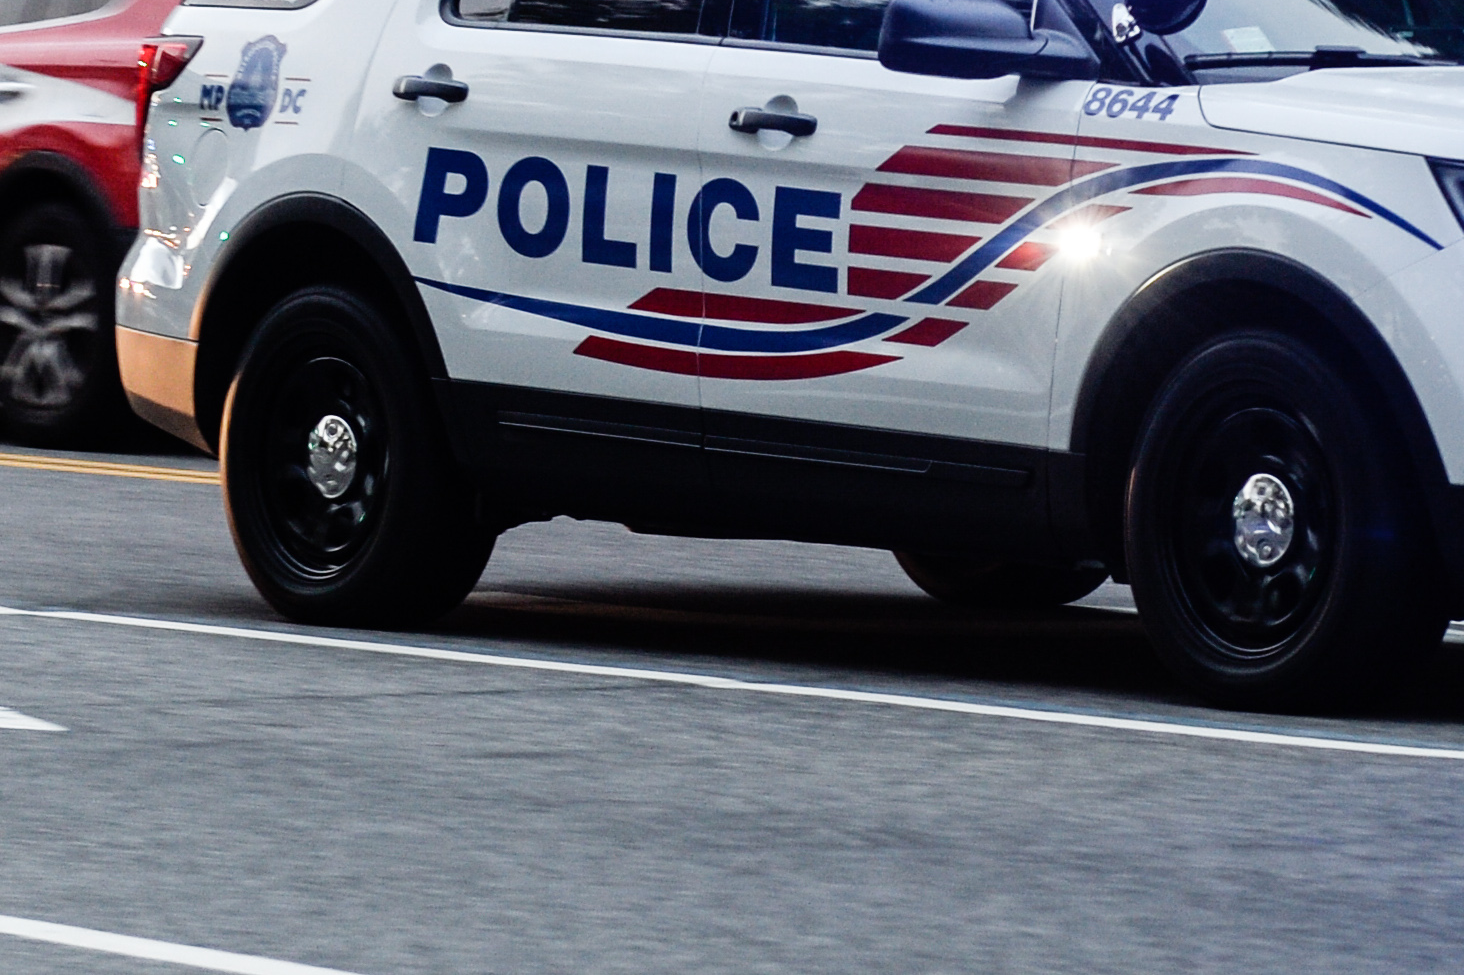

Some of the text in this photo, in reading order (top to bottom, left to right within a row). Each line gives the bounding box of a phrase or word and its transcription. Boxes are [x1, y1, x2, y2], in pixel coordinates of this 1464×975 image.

[201, 84, 225, 111] MP
[279, 88, 307, 114] DC
[1083, 87, 1180, 121] 8644
[413, 146, 842, 294] POLICE
